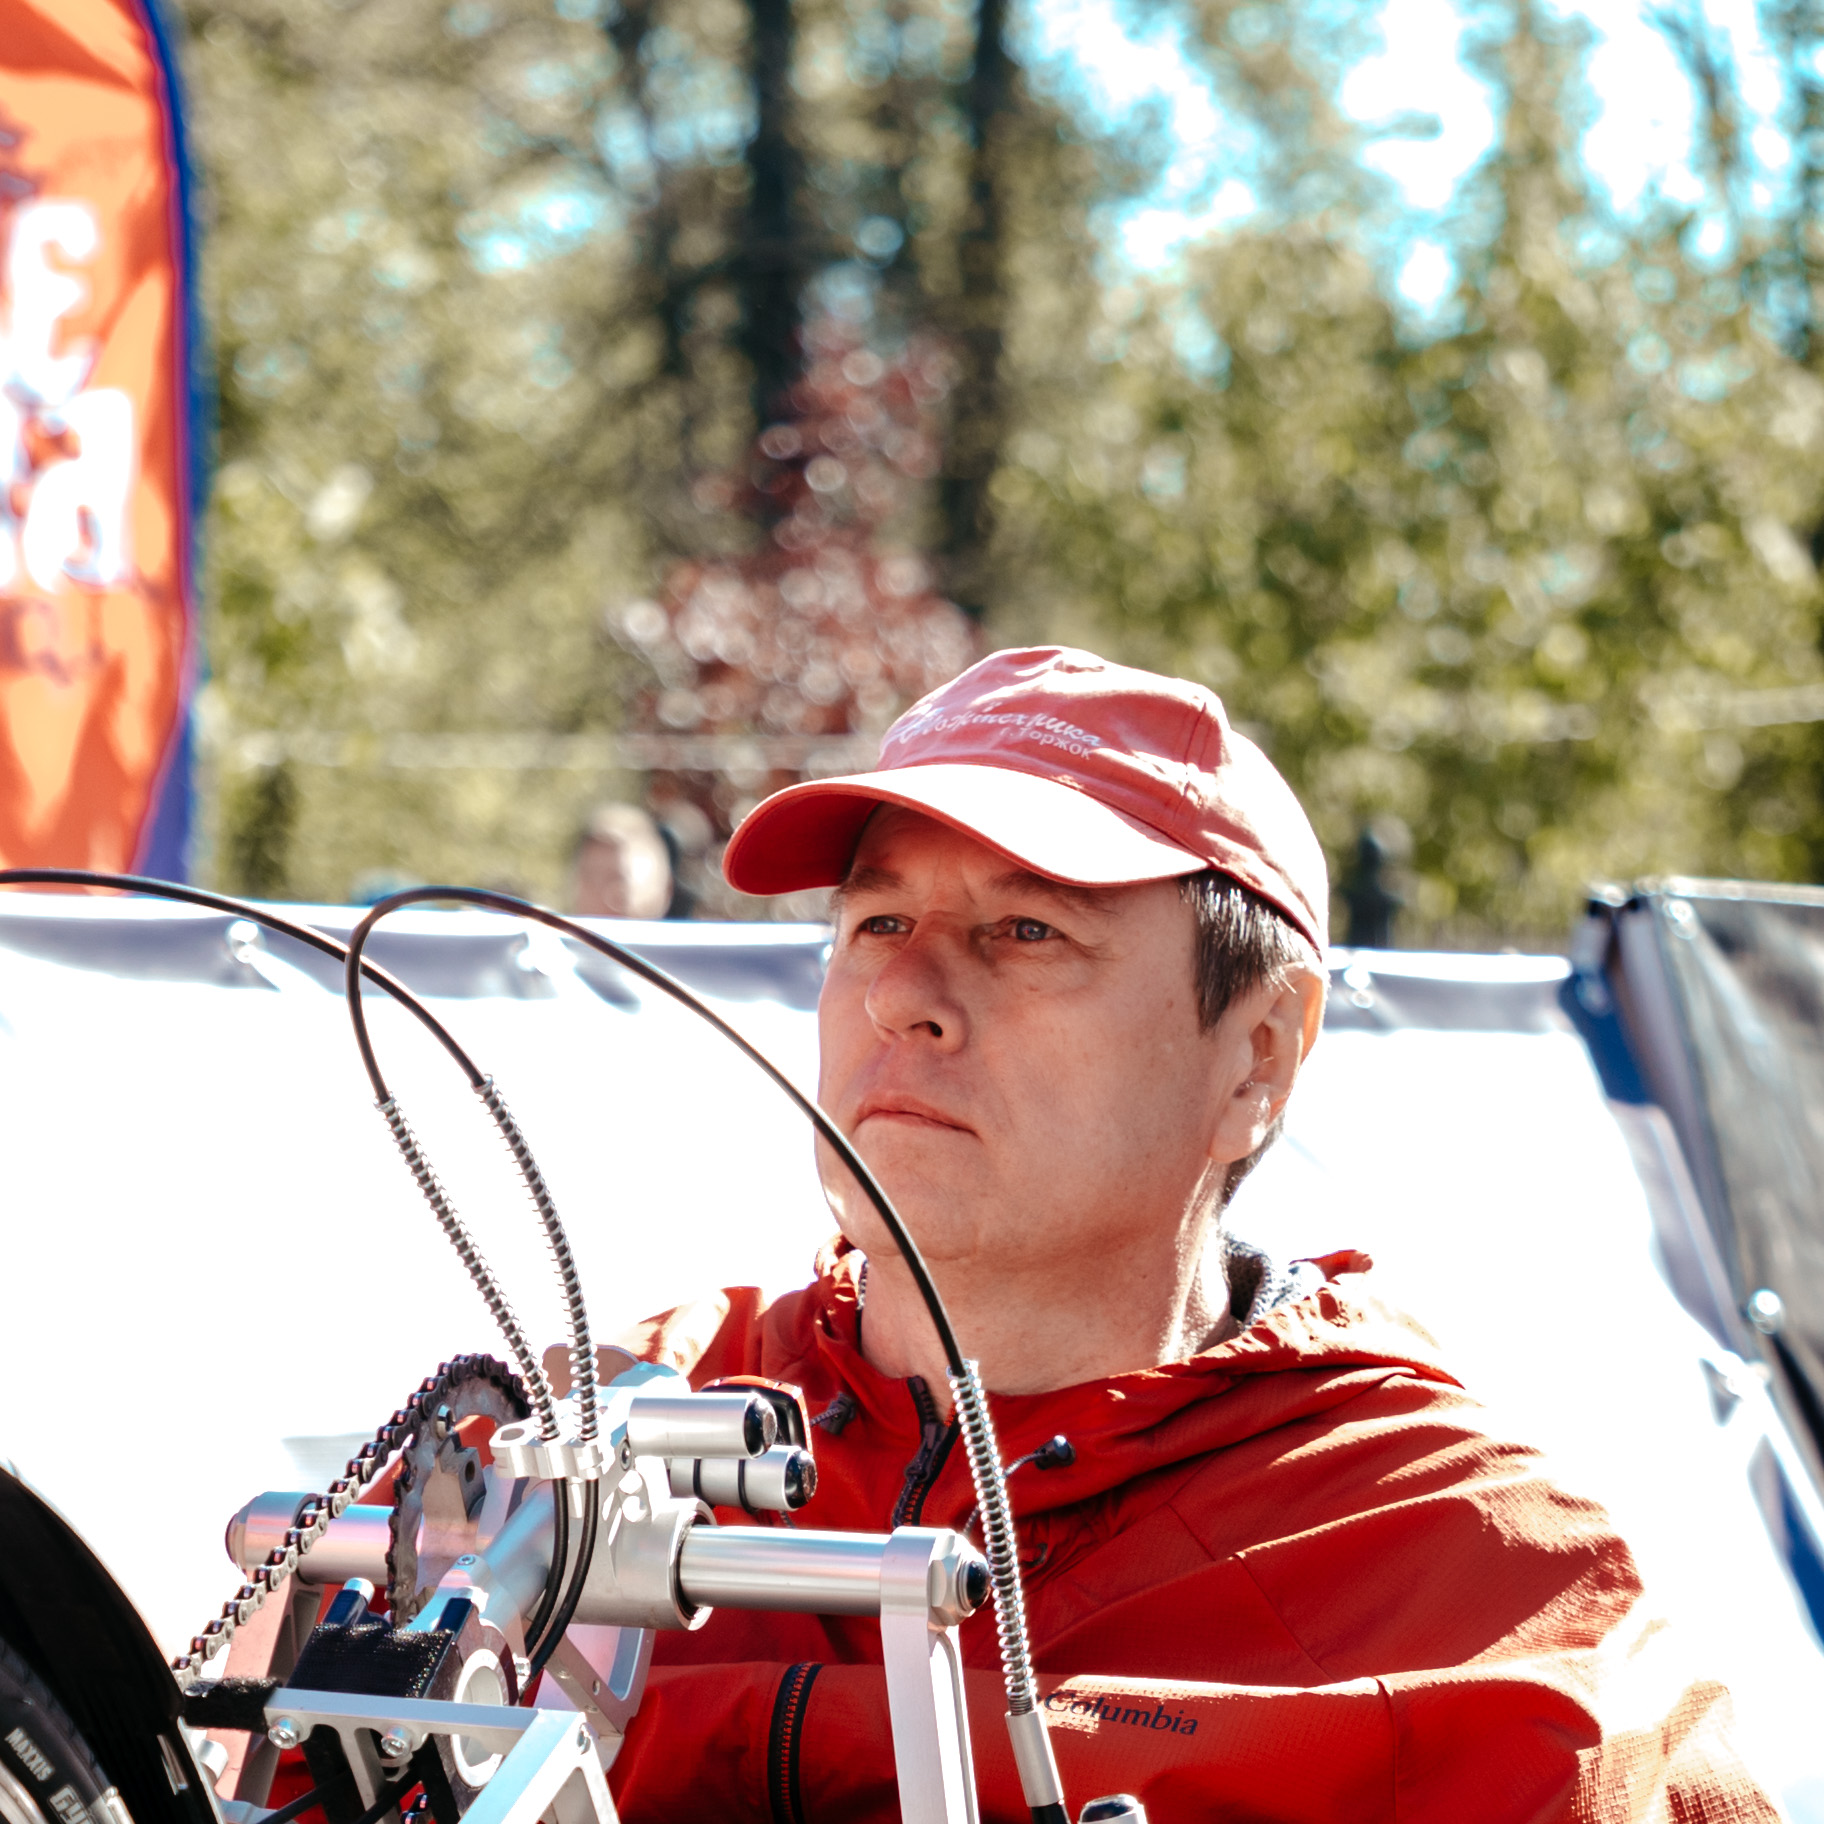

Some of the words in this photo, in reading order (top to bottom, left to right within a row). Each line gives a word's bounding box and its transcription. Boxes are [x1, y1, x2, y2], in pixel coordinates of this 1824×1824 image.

[1018, 726, 1091, 760] Торжок
[1043, 1690, 1199, 1736] Columbia
[5, 1727, 55, 1782] MAXXIS
